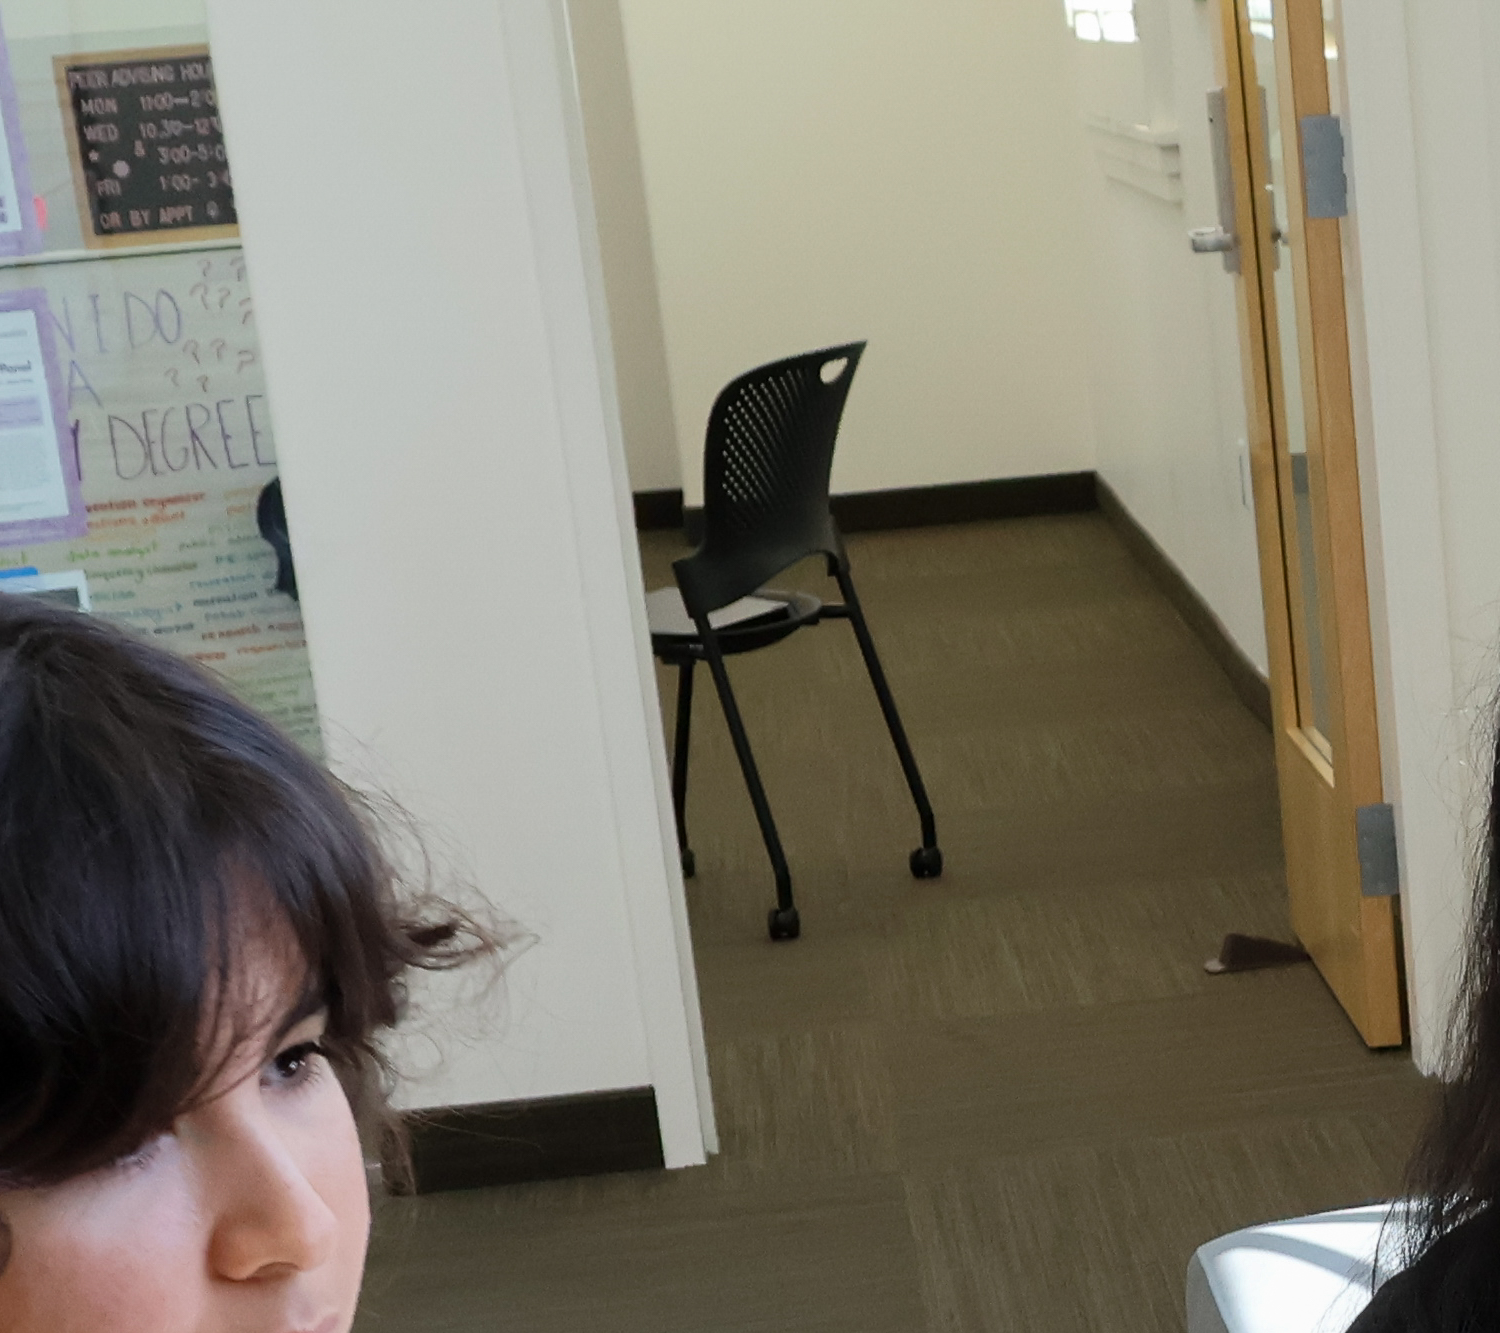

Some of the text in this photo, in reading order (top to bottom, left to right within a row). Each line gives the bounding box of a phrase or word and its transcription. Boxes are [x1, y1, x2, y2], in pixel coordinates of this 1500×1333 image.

[80, 98, 118, 115] MON
[84, 122, 119, 142] WED
[97, 178, 122, 197] FRI
[100, 205, 193, 229] OR BY APPT
[124, 289, 183, 351] DO
[0, 360, 32, 373] Panel
[108, 394, 278, 481] DEGREE
